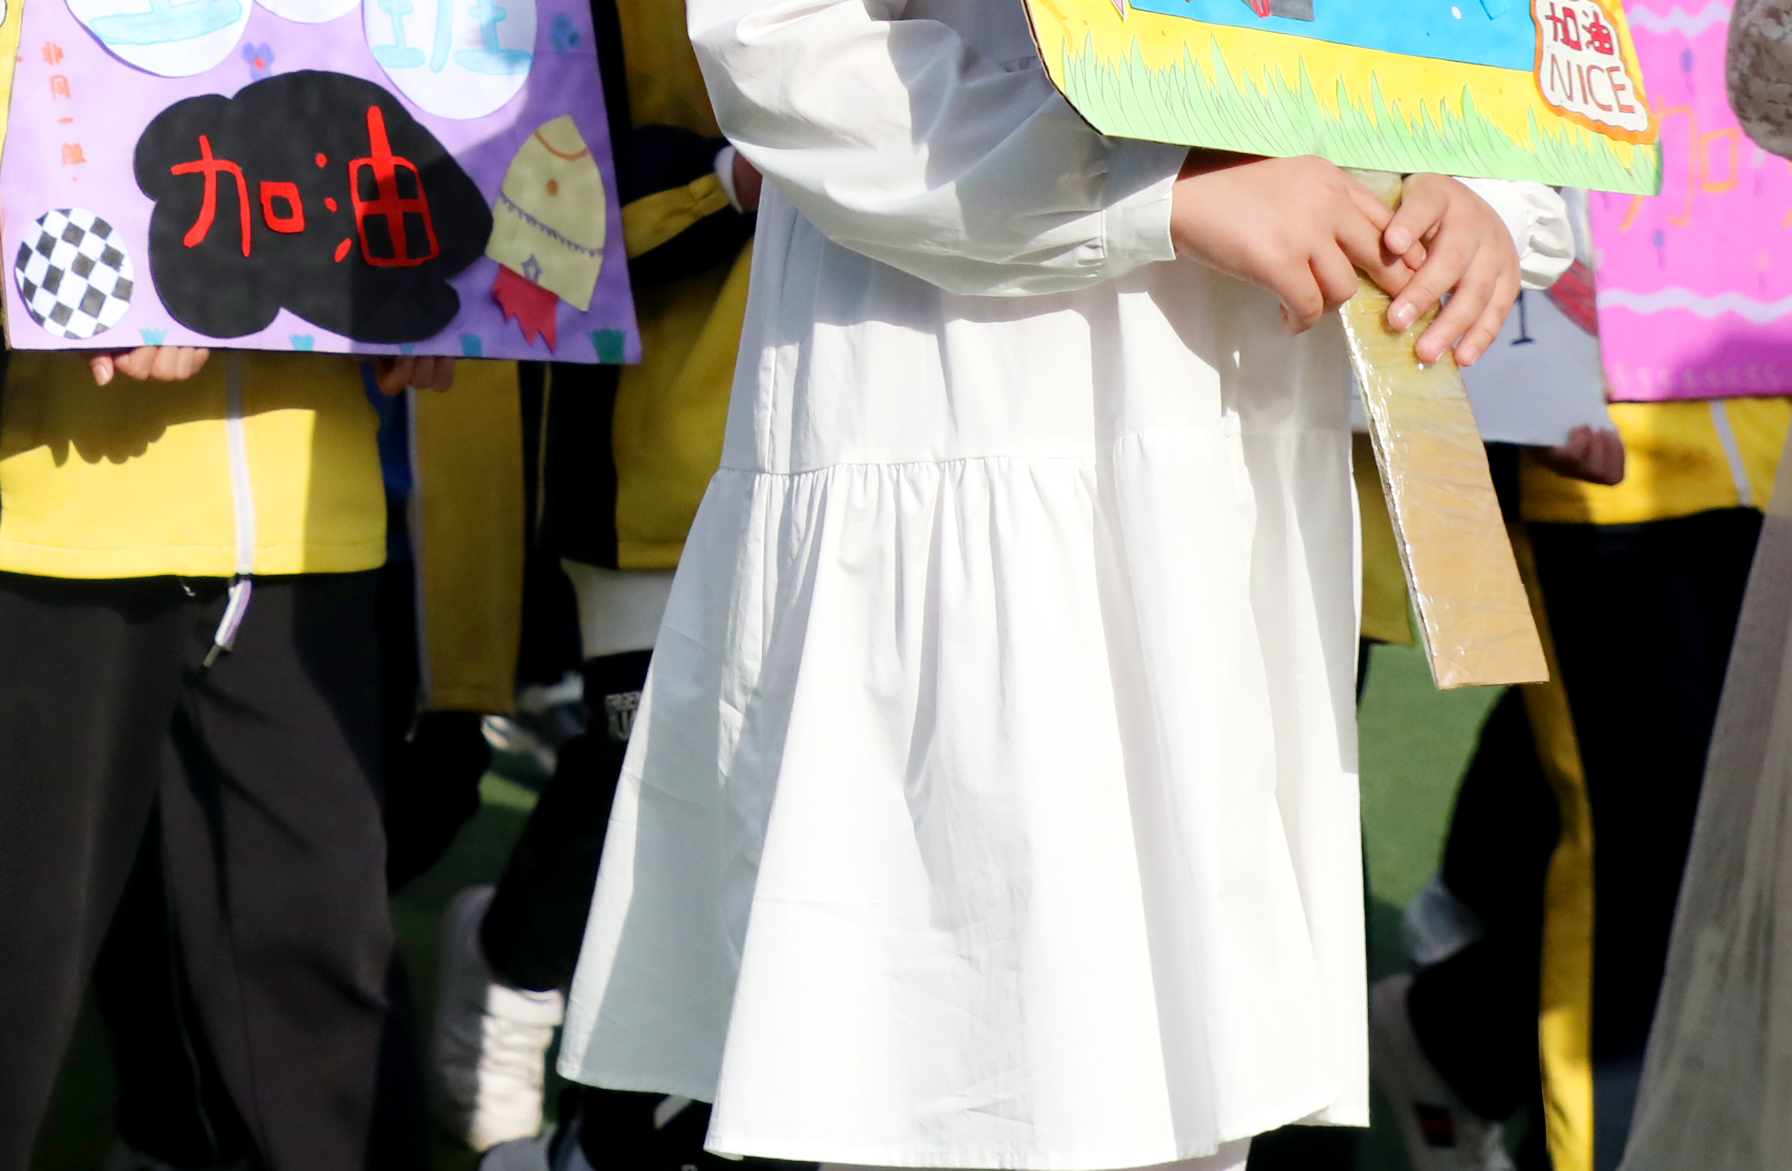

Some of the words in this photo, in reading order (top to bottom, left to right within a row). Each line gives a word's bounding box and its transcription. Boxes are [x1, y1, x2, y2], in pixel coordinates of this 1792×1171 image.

[1545, 2, 1614, 55] 加油
[1550, 53, 1636, 113] NICE
[171, 105, 440, 267] 加油
